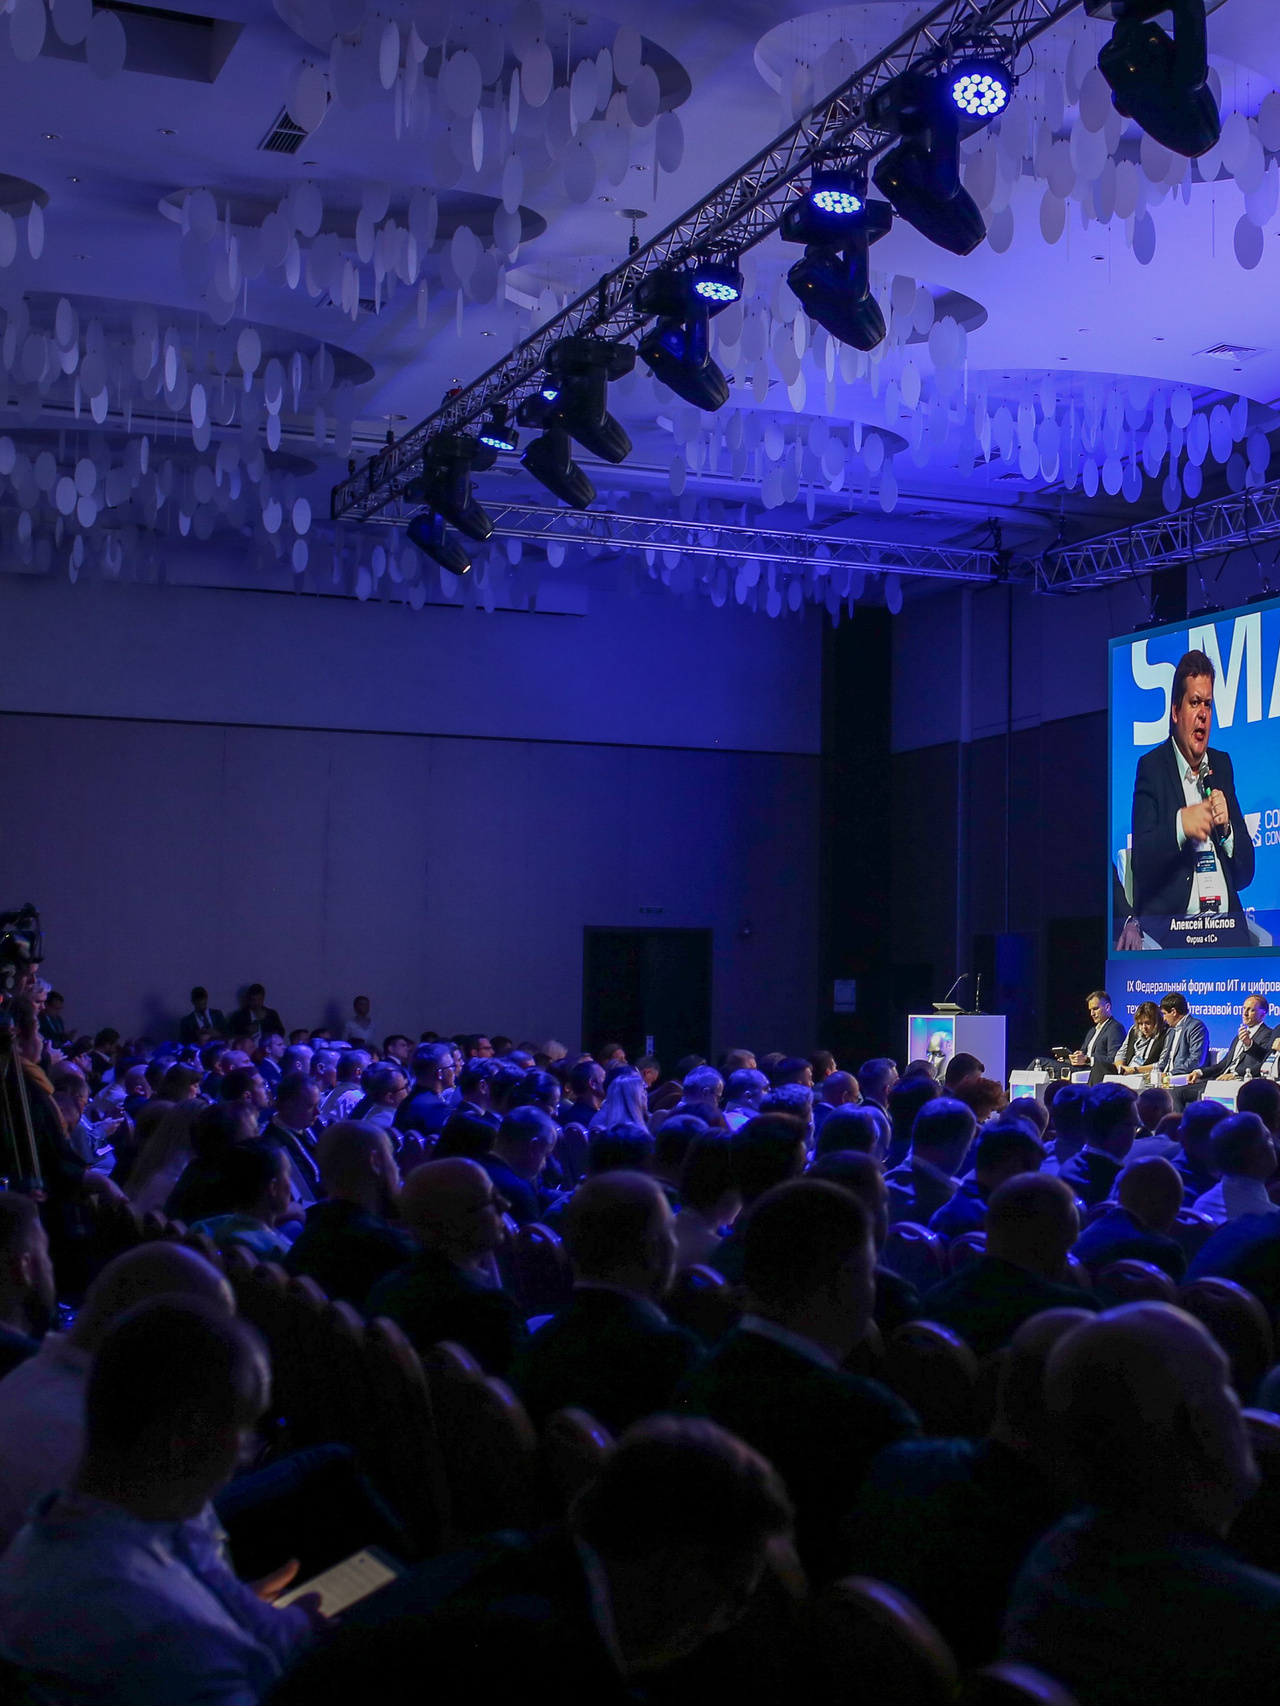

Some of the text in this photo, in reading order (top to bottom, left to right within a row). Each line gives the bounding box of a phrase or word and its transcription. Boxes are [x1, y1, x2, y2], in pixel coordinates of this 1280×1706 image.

[1170, 917, 1235, 930] Алексей Кислов
[1186, 935, 1204, 945] Фирма
[1127, 980, 1134, 992] IX
[1135, 979, 1186, 994] Федеральный
[1188, 978, 1214, 995] форум
[1215, 981, 1226, 992] по
[1227, 979, 1240, 991] ИТ
[1240, 981, 1246, 992] и
